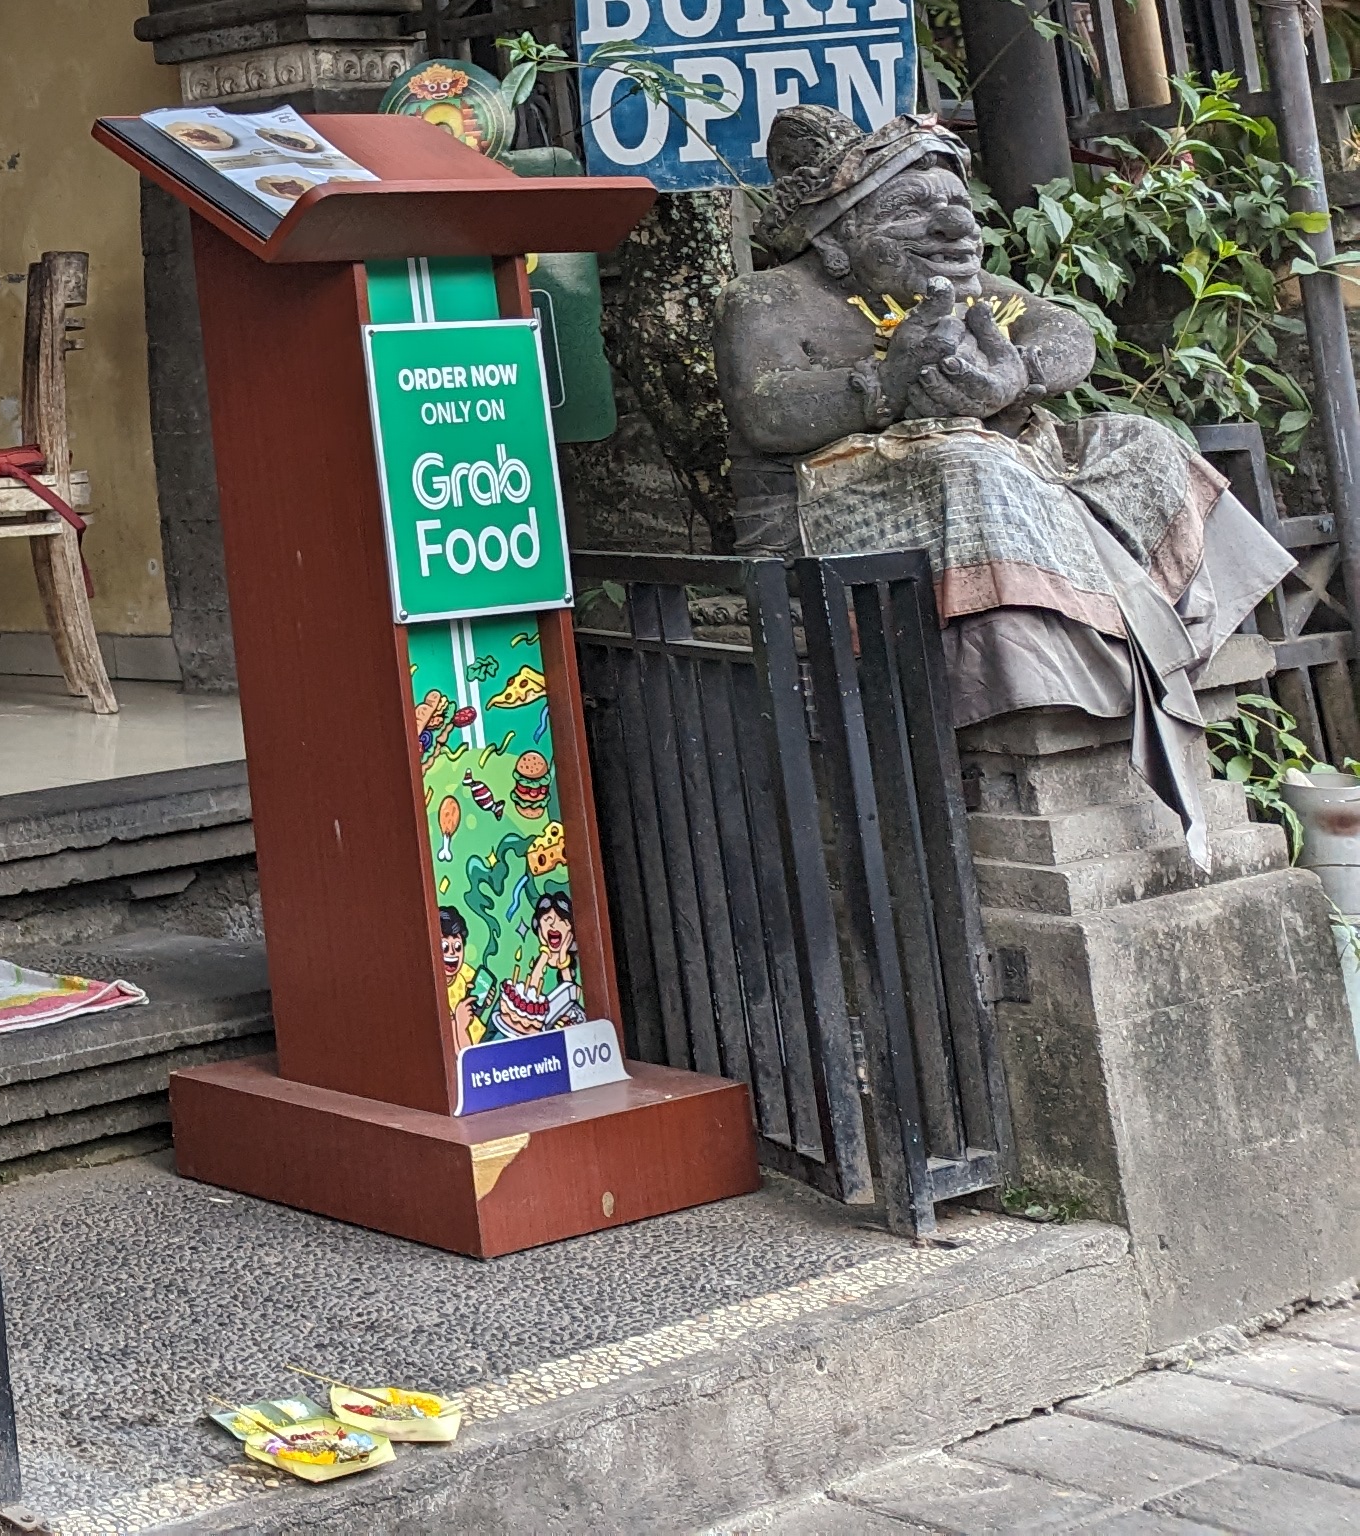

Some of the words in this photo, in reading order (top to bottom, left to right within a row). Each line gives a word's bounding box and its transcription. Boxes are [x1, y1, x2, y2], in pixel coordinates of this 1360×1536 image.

[398, 366, 468, 391] ORDER
[471, 364, 518, 387] NOW
[421, 400, 471, 425] ONLY
[475, 398, 506, 422] ON
[412, 444, 531, 510] Grab
[415, 507, 540, 577] Food
[572, 1042, 612, 1068] OVO
[471, 1070, 492, 1088] It's
[493, 1063, 532, 1084] better
[533, 1055, 562, 1075] with
